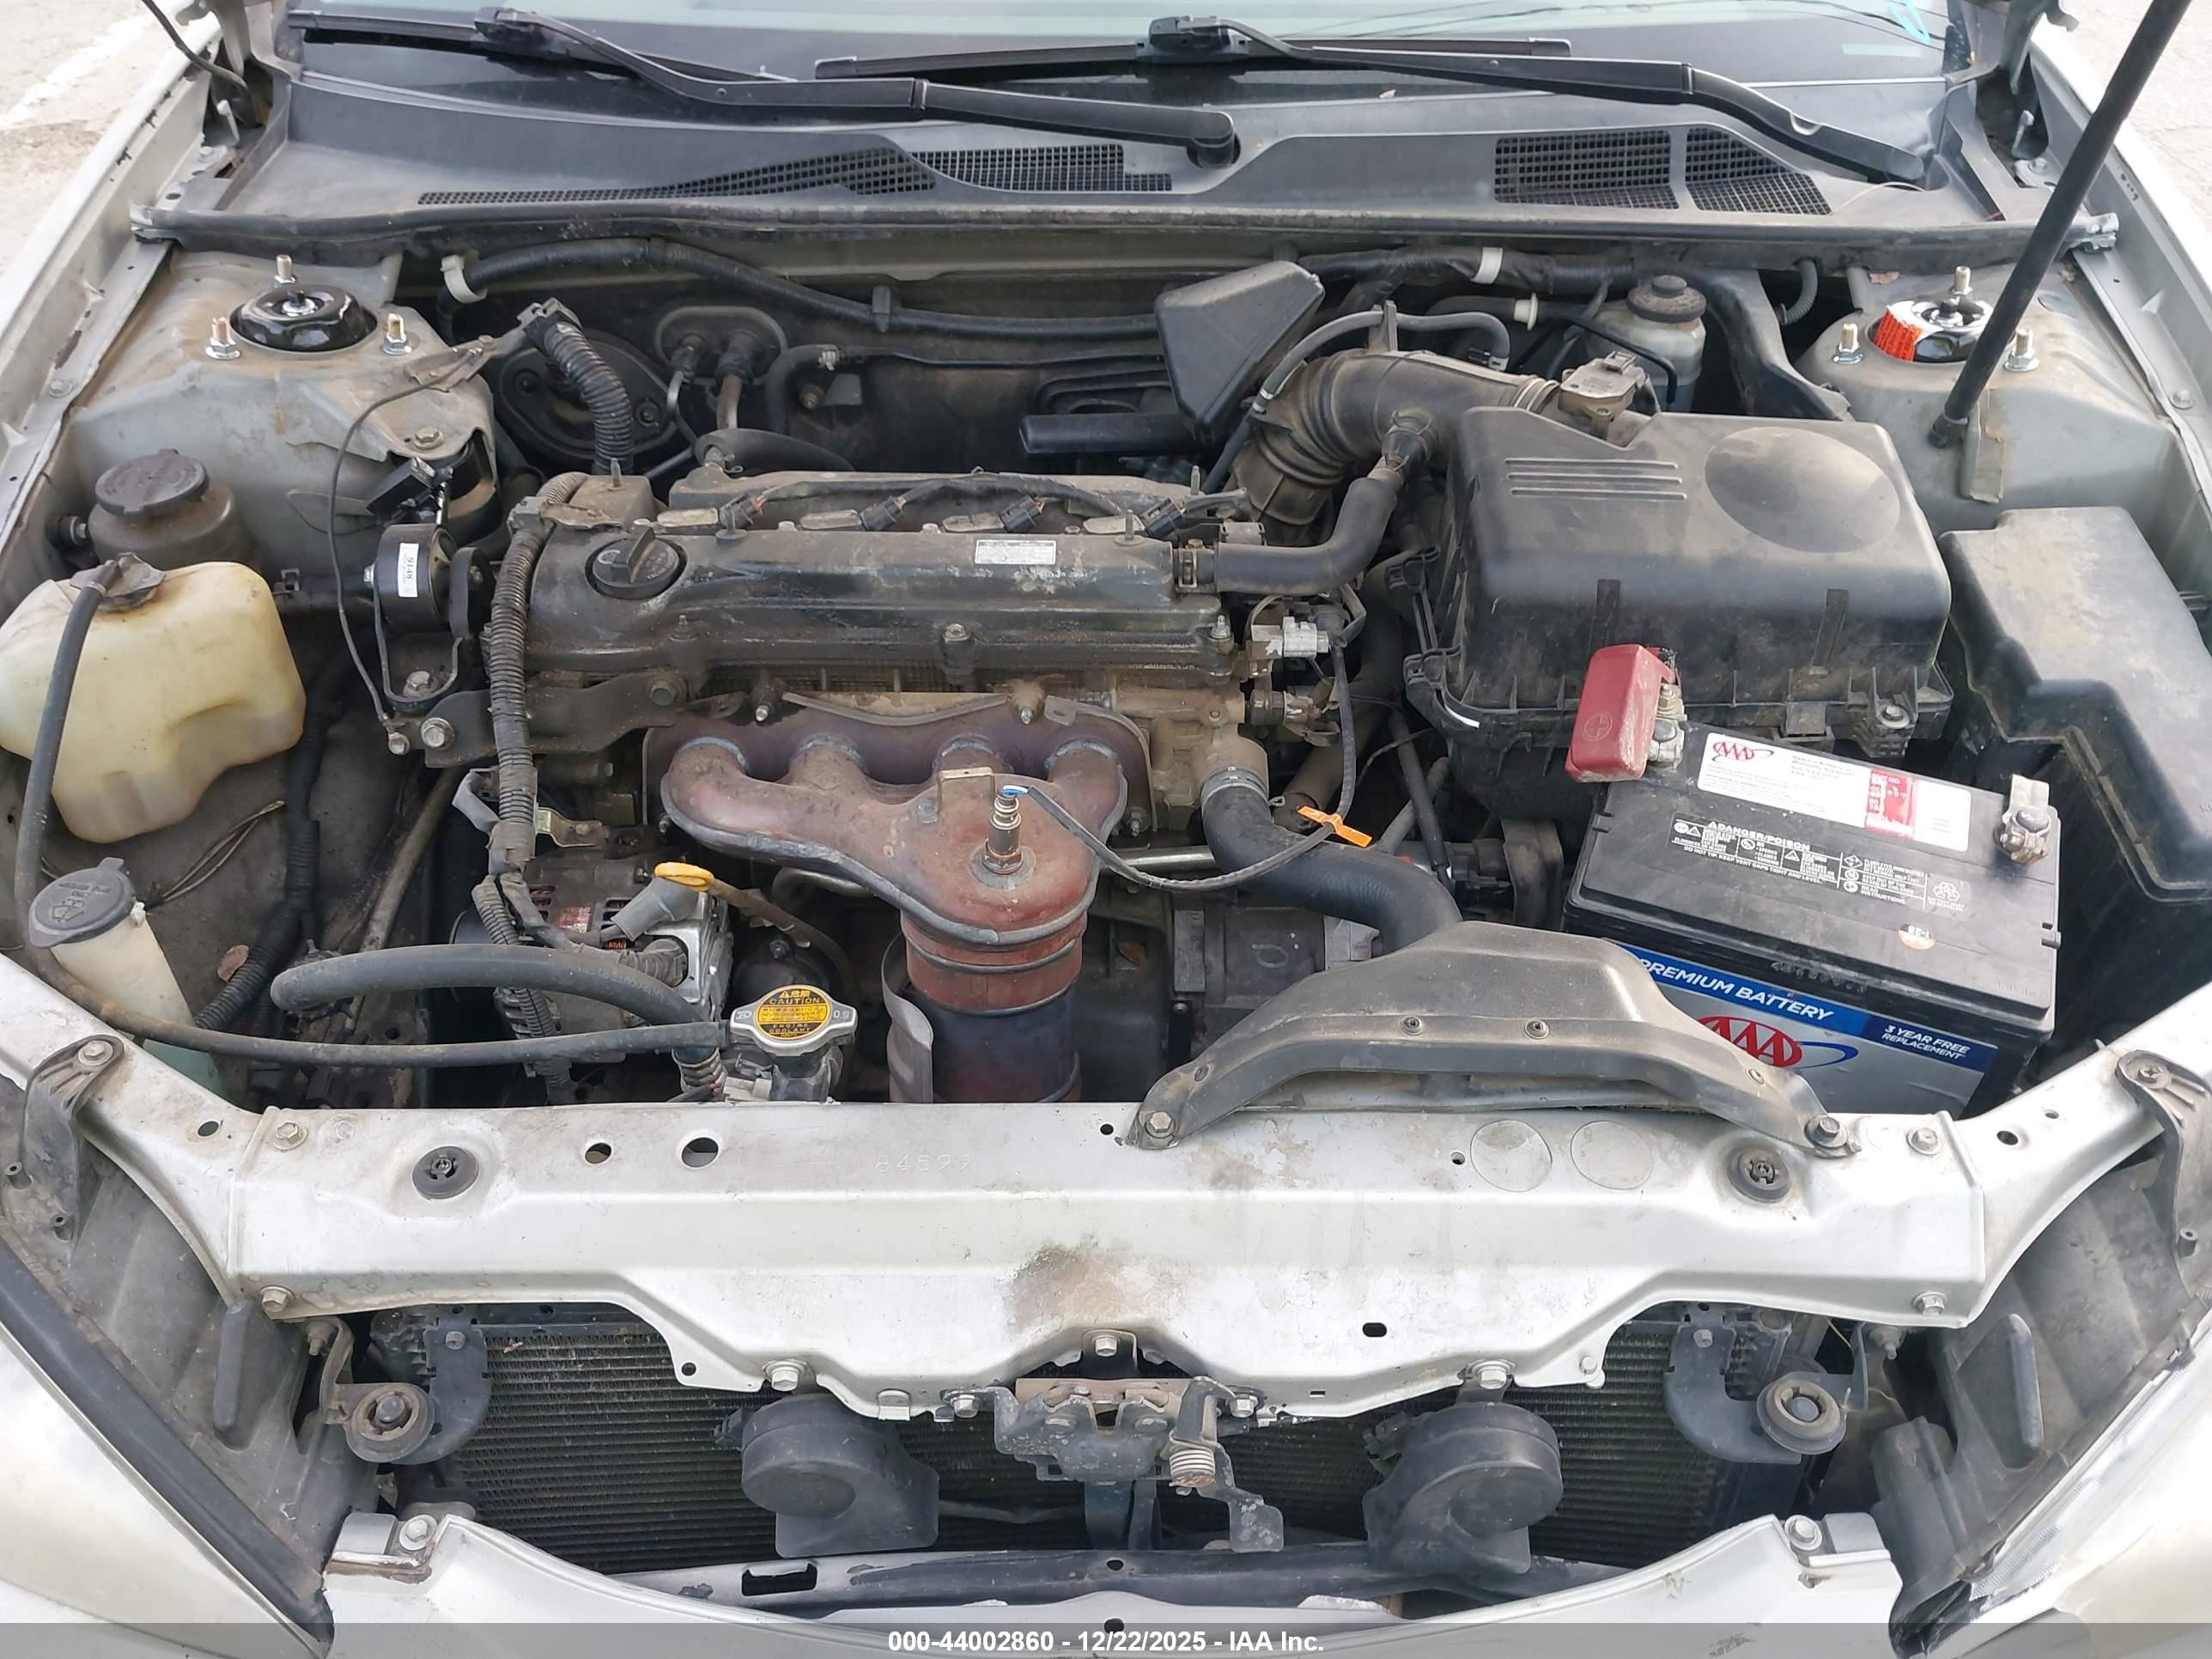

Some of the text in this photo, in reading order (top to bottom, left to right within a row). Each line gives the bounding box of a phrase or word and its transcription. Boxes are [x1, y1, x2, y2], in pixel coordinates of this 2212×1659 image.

[1713, 741, 1755, 761] AAA
[1717, 823, 1810, 851] DANGER/POISON
[1735, 987, 1835, 1022] BATTERY
[1881, 1032, 1966, 1060] REPLACEMENT
[1884, 1024, 1971, 1054] 3 YEAR FREE
